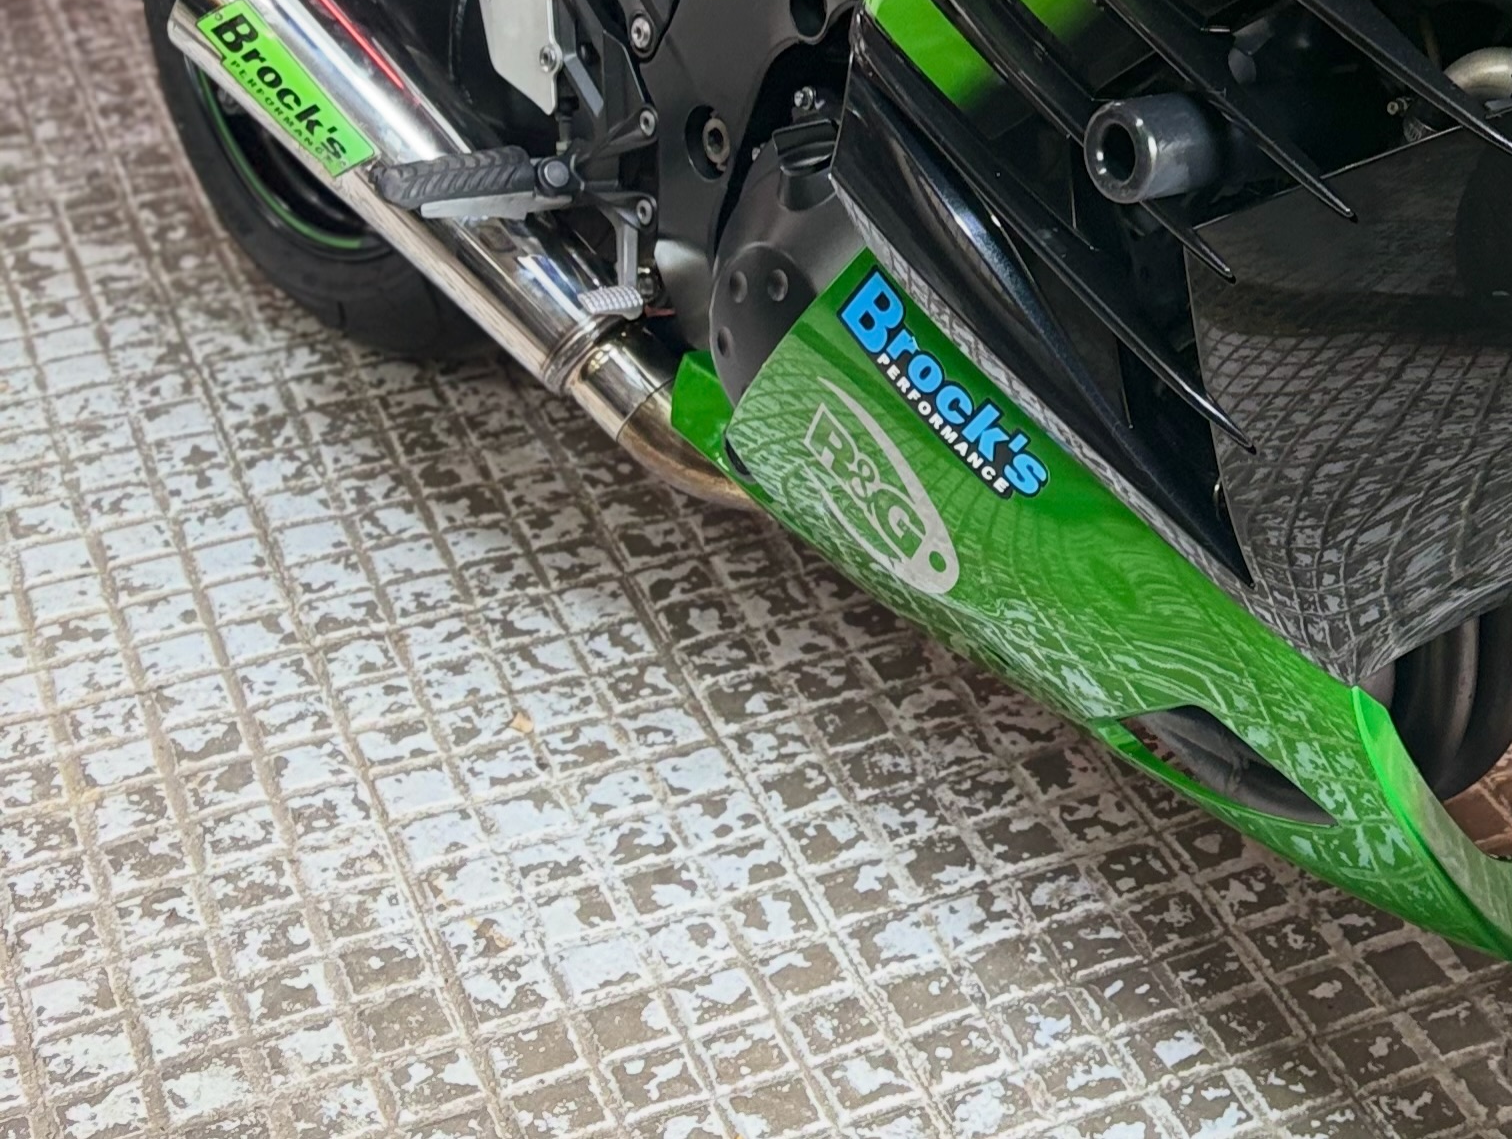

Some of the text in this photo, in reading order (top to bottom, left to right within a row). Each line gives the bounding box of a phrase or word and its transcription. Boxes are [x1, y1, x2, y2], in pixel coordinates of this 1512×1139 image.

[211, 13, 347, 160] Brock's
[230, 60, 334, 165] PERFORMANCE
[838, 267, 1049, 497] Brock's
[876, 352, 1010, 494] PERFORMANCE
